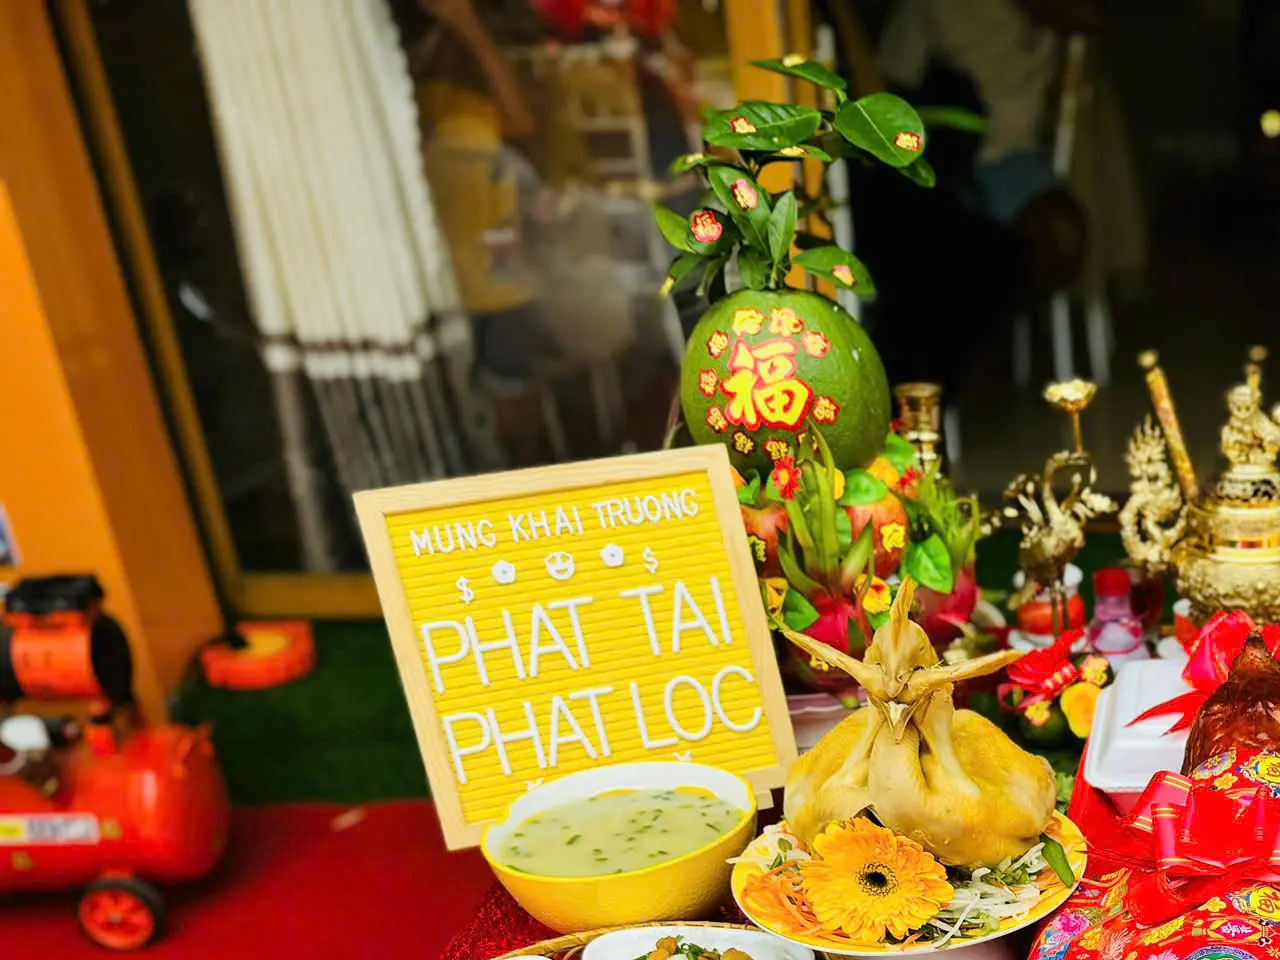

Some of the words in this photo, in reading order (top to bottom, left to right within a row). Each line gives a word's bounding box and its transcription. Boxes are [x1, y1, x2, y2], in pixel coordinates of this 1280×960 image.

[722, 340, 813, 430] 福
[410, 519, 497, 557] MUNG
[508, 507, 585, 543] KHAI
[592, 488, 700, 531] TRUONG
[421, 596, 593, 695] PHAT
[619, 576, 732, 657] TAI
[442, 686, 615, 785] PHAT
[629, 665, 763, 750] LOC
